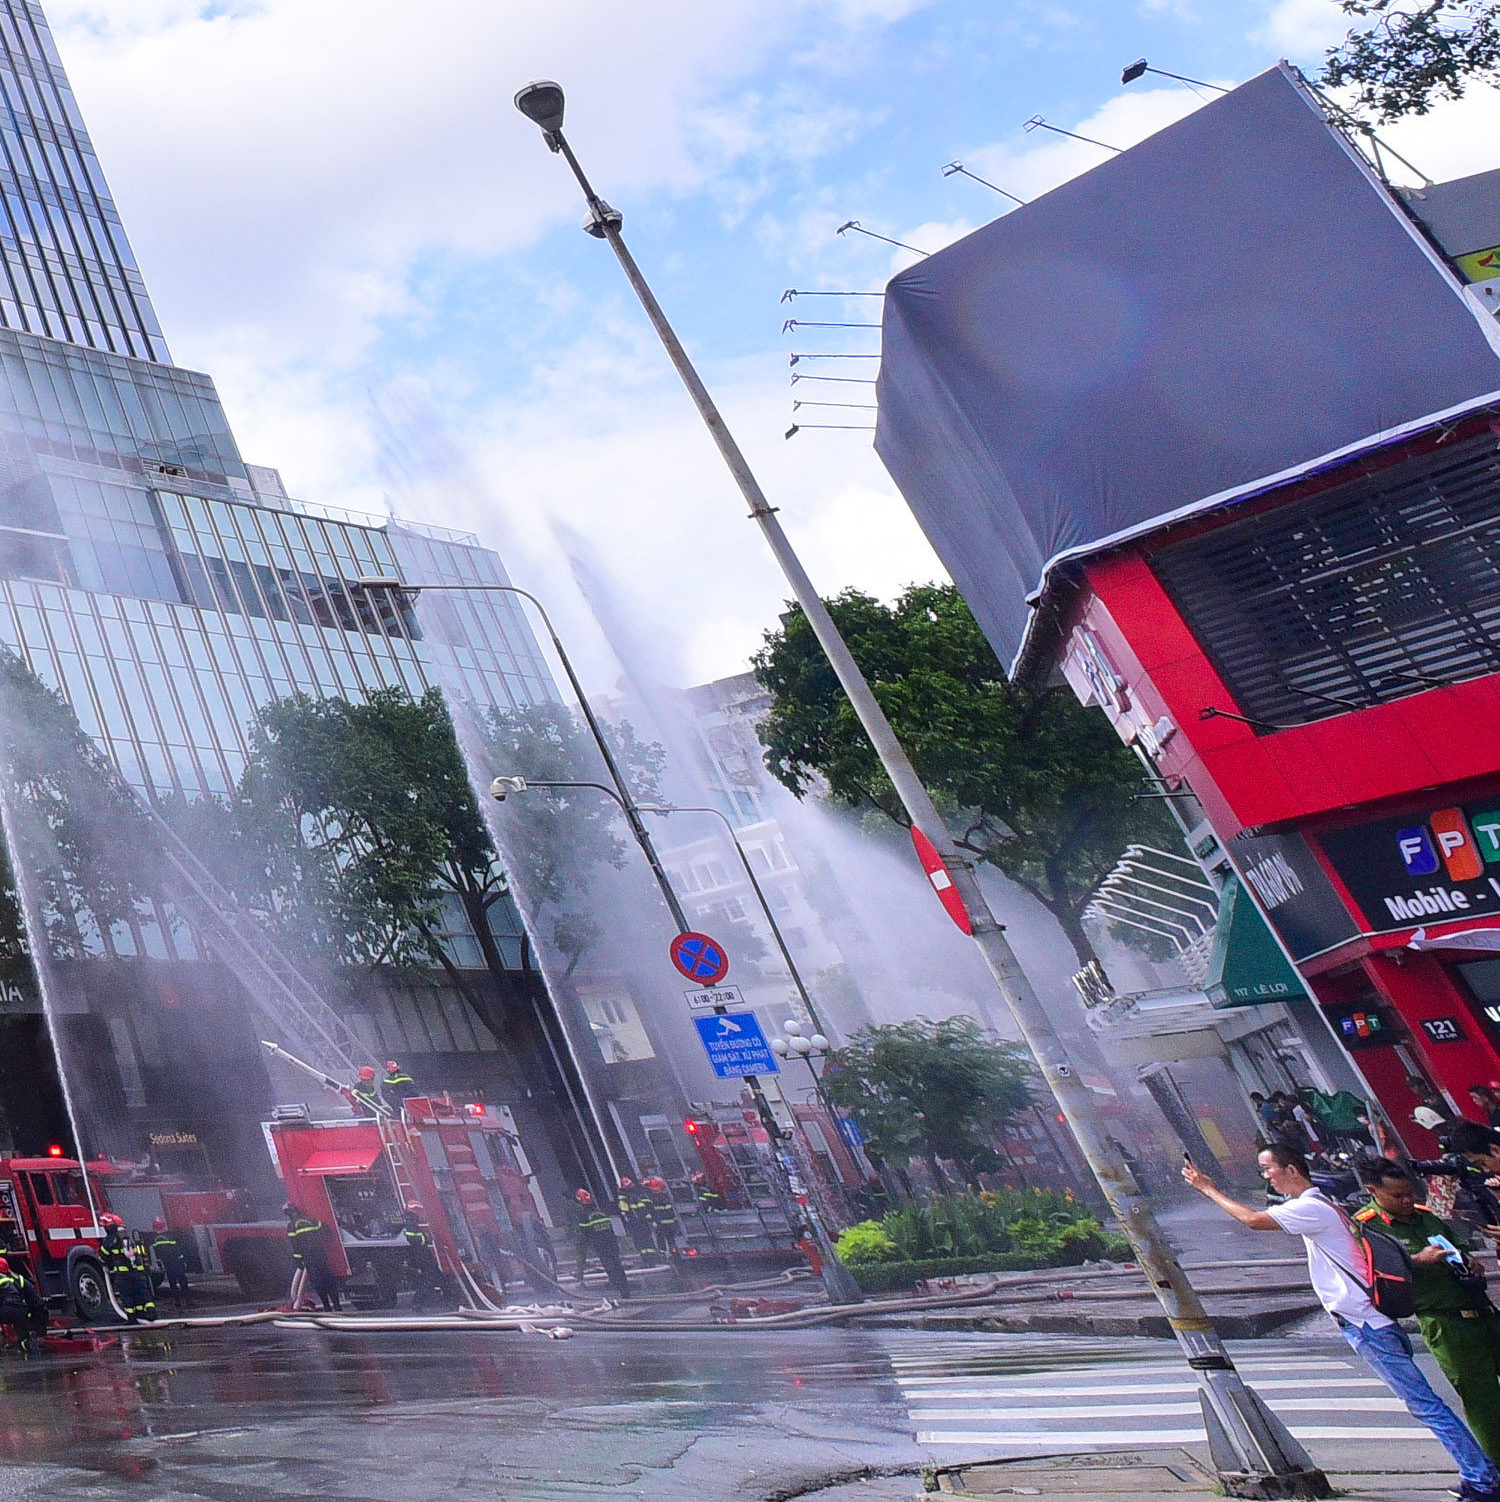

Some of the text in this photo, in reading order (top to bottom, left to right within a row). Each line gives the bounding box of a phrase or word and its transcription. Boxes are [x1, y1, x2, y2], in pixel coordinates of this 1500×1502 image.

[1384, 886, 1471, 921] Mobile
[1234, 987, 1248, 997] 117
[1253, 984, 1268, 995] LÊ
[1343, 1017, 1380, 1033] FPT
[1424, 1020, 1456, 1035] 121
[149, 1131, 197, 1145] Sedona Suites
